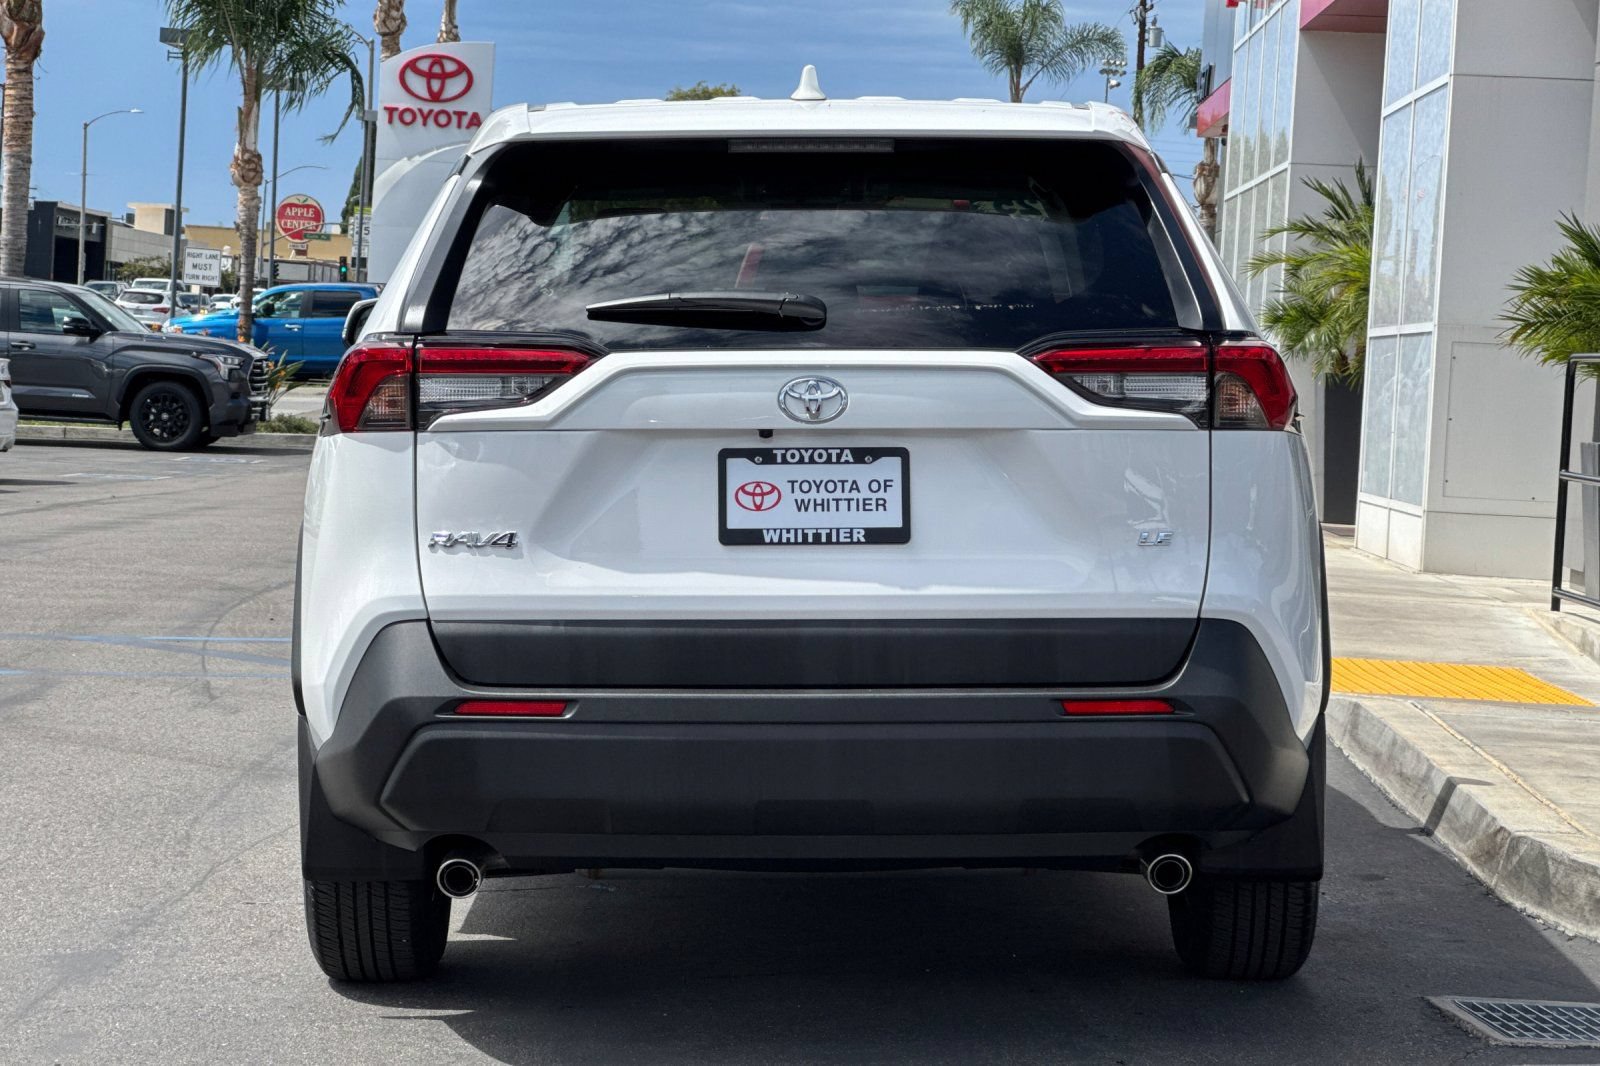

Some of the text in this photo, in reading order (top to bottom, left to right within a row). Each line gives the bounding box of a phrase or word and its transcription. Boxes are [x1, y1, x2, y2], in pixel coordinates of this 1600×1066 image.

[383, 106, 482, 129] TOYOTA
[285, 207, 315, 217] APPLE
[281, 219, 317, 231] CENTER
[192, 262, 212, 271] MUST
[773, 449, 855, 463] TOYOTA
[787, 479, 894, 494] TOYOTA OF
[794, 497, 888, 512] WHITTIER
[428, 530, 518, 549] RAV4
[762, 528, 866, 543] WHITTIER
